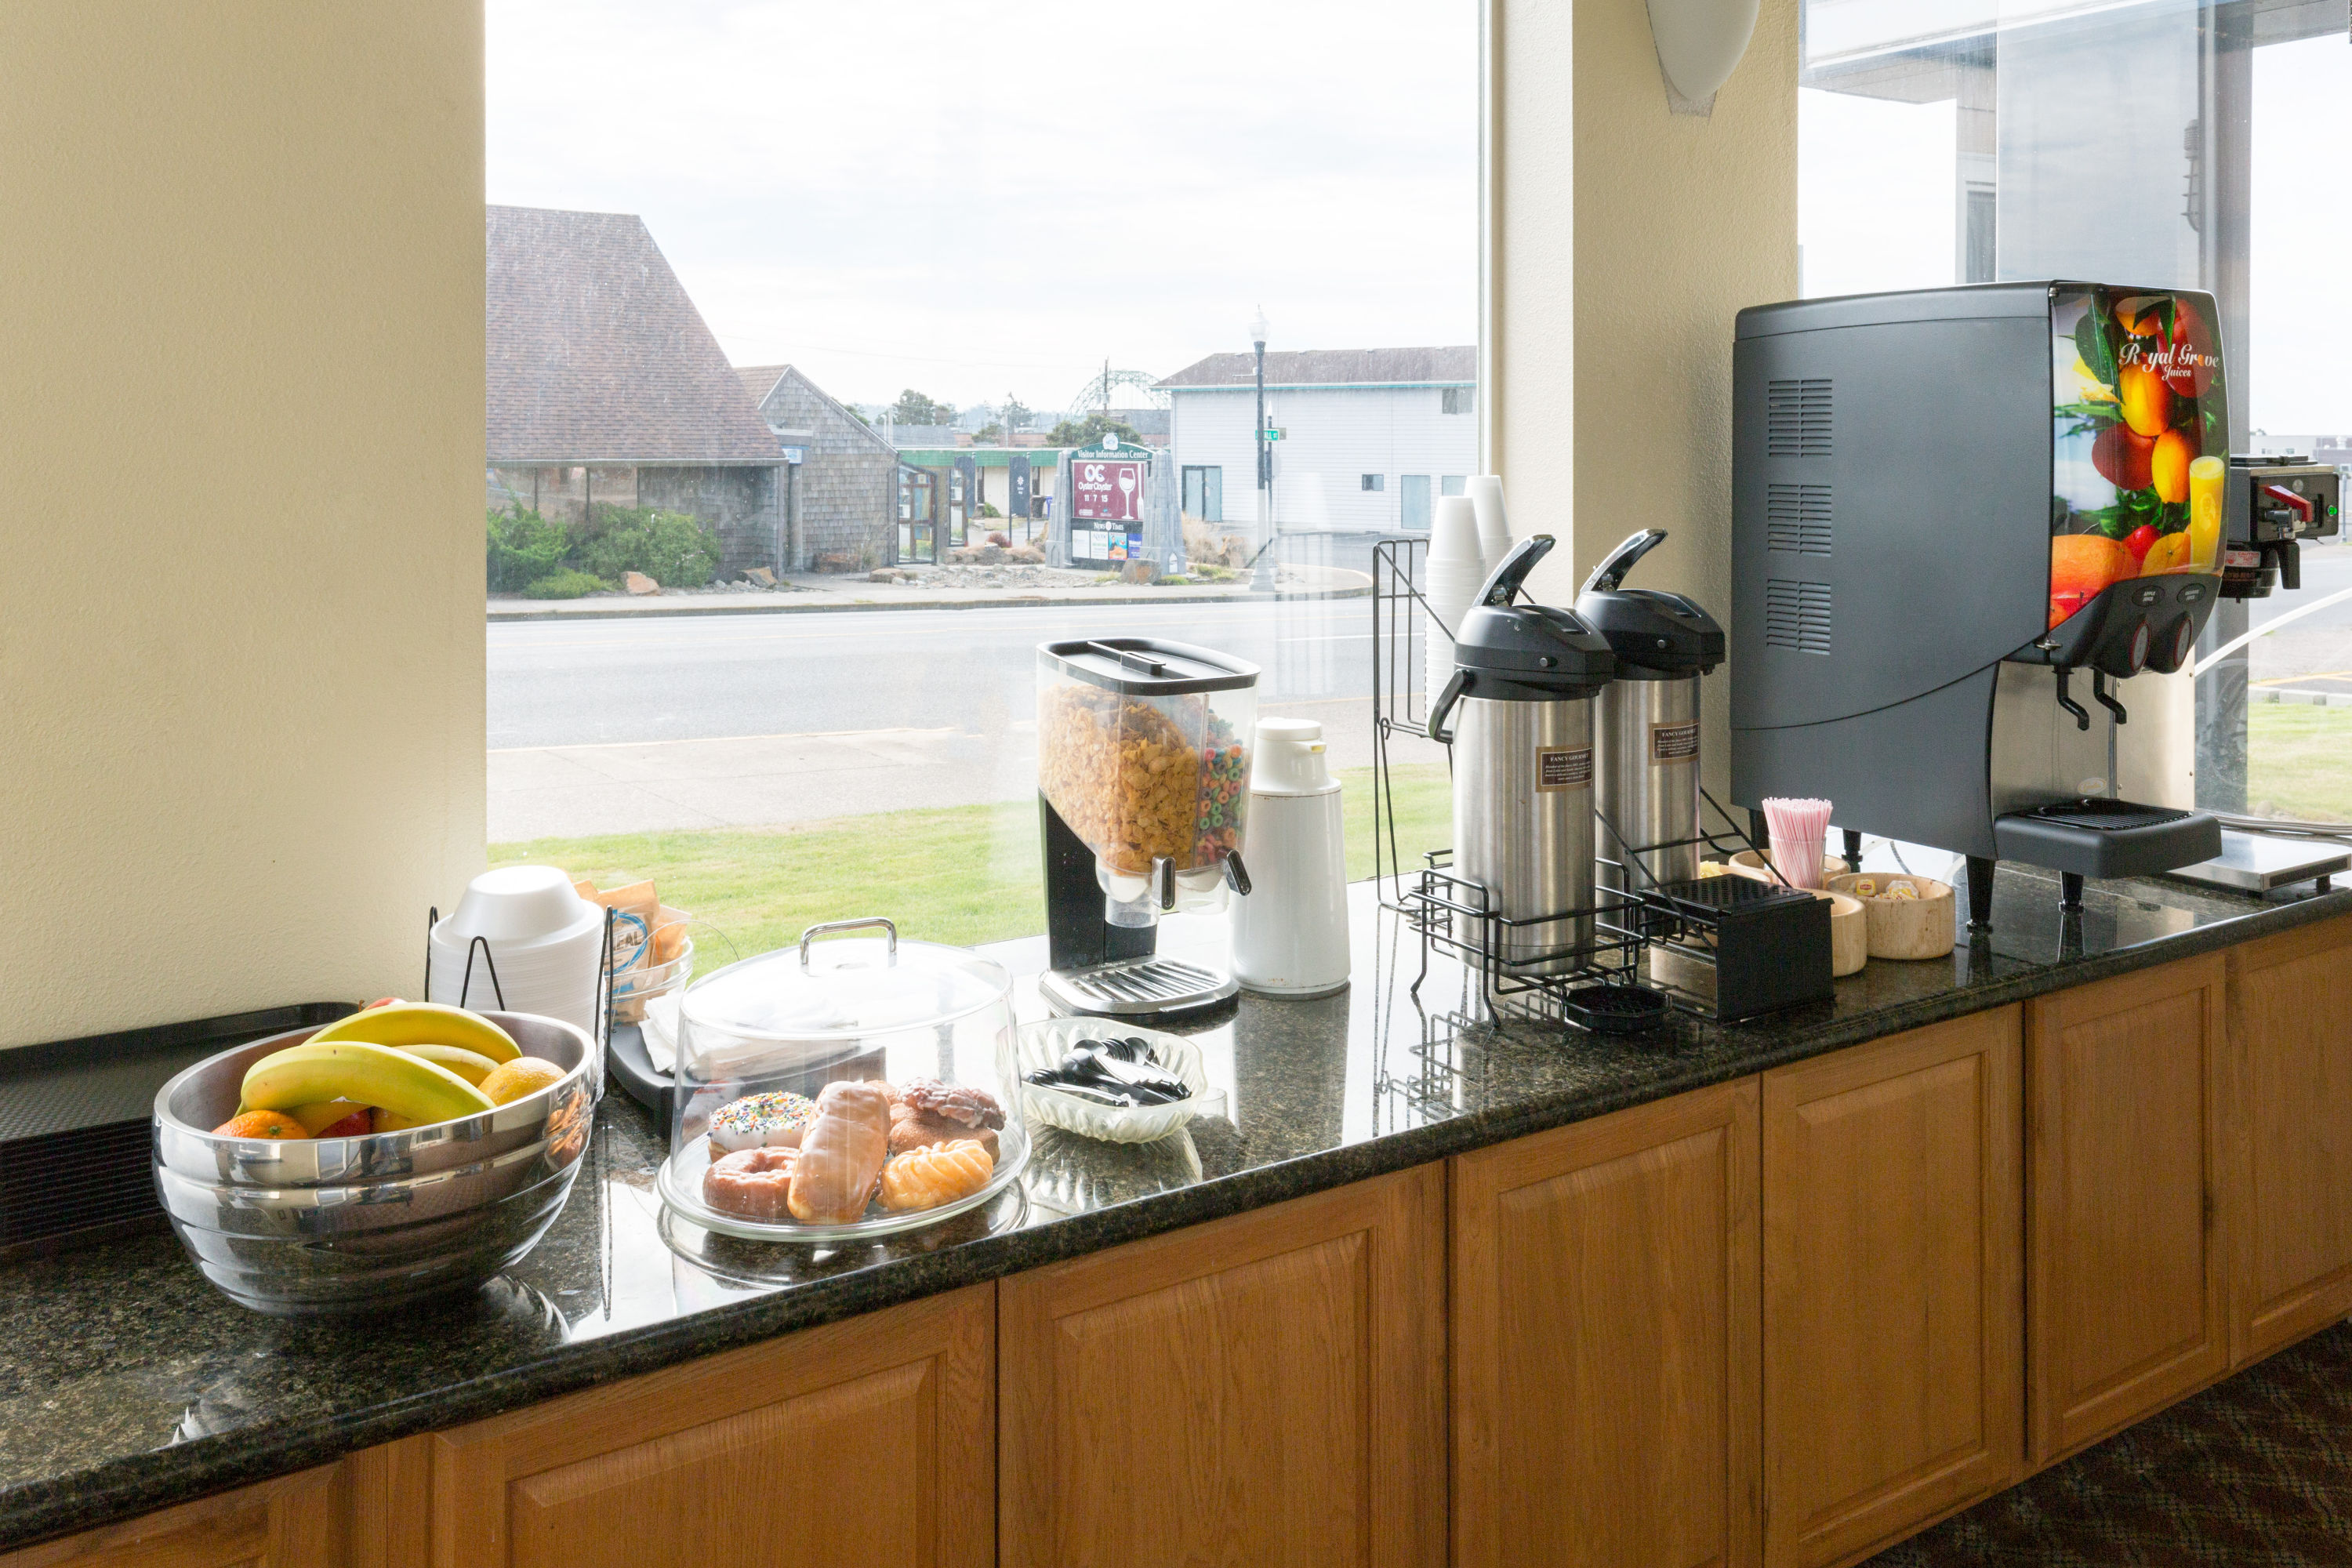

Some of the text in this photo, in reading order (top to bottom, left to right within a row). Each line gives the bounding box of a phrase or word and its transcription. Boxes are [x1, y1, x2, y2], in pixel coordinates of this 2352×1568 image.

[2178, 343, 2220, 368] Grove
[2161, 364, 2192, 381] Juices
[1077, 450, 1148, 459] Visitor Information Center
[1084, 464, 1105, 482] OC
